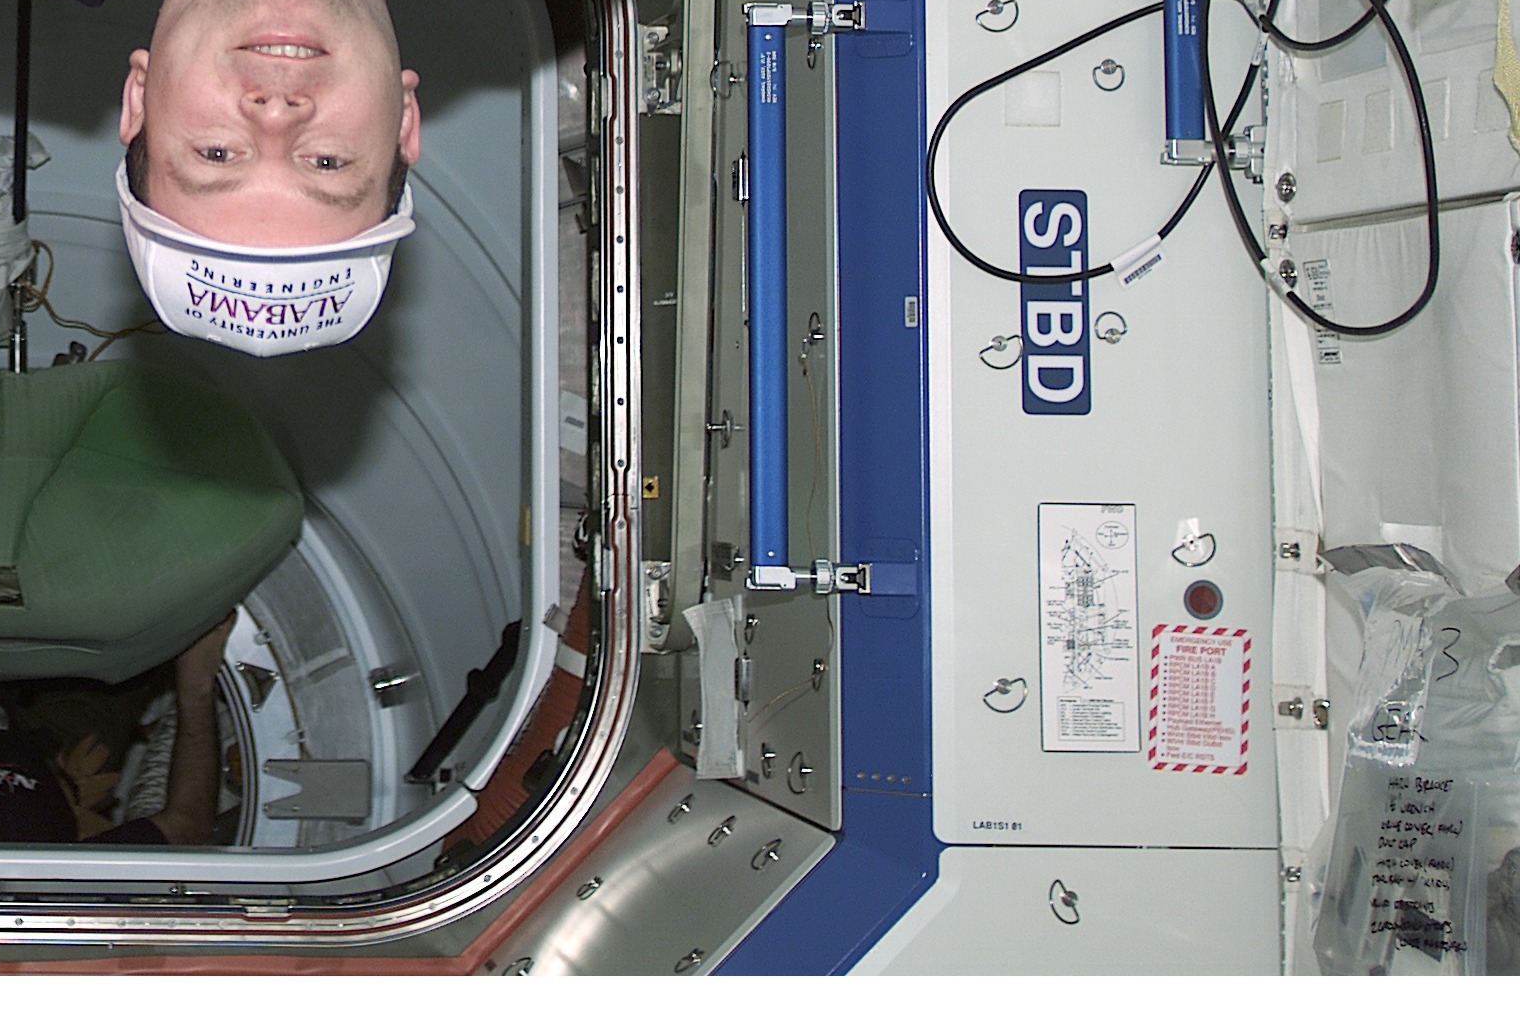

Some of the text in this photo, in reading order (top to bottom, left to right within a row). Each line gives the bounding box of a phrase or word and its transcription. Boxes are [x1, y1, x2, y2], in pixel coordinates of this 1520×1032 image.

[191, 258, 352, 294] ENGINEERING
[187, 281, 354, 325] ALABAMA
[1024, 201, 1085, 403] STBD
[209, 316, 309, 339] UNIVERSITY
[316, 316, 343, 331] THE
[1176, 645, 1227, 656] FIRE PORT
[972, 821, 1009, 830] LAB1S1
